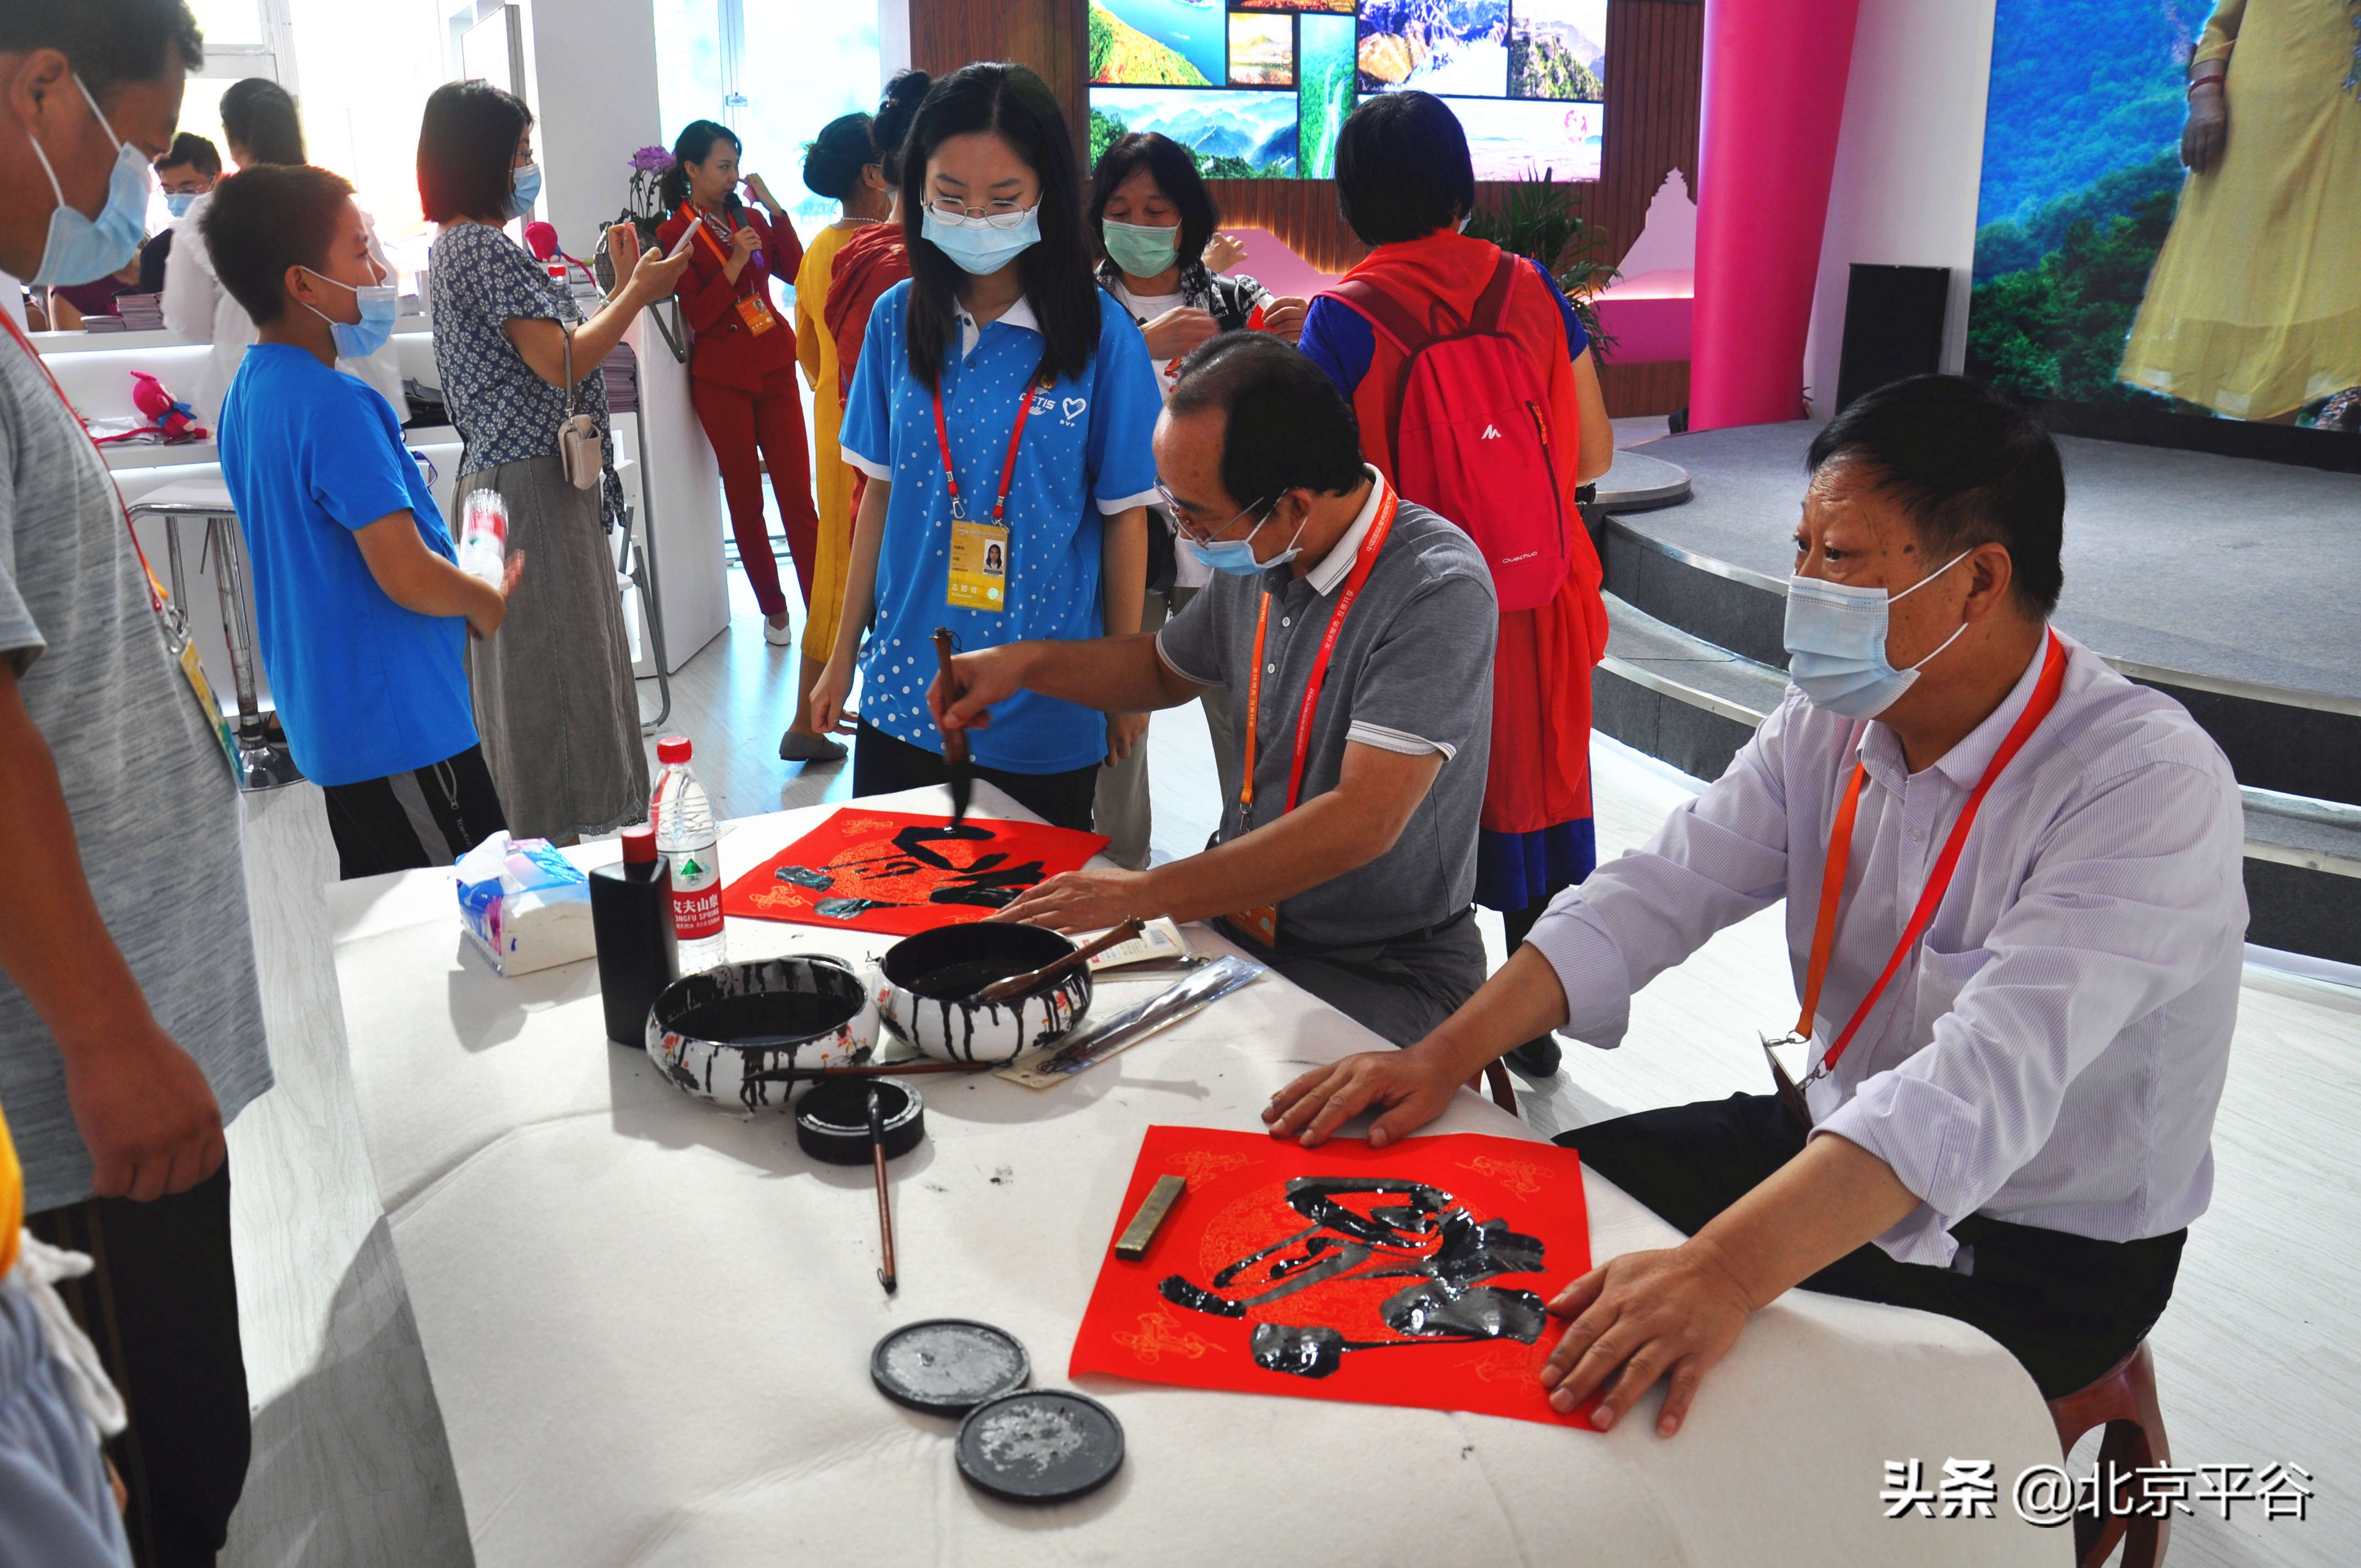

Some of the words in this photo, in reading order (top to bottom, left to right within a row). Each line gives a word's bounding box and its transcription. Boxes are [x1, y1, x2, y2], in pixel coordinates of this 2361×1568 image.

[1019, 392, 1056, 410] CFTIS
[1502, 551, 1538, 564] Quechua
[675, 914, 697, 922] ONGFU
